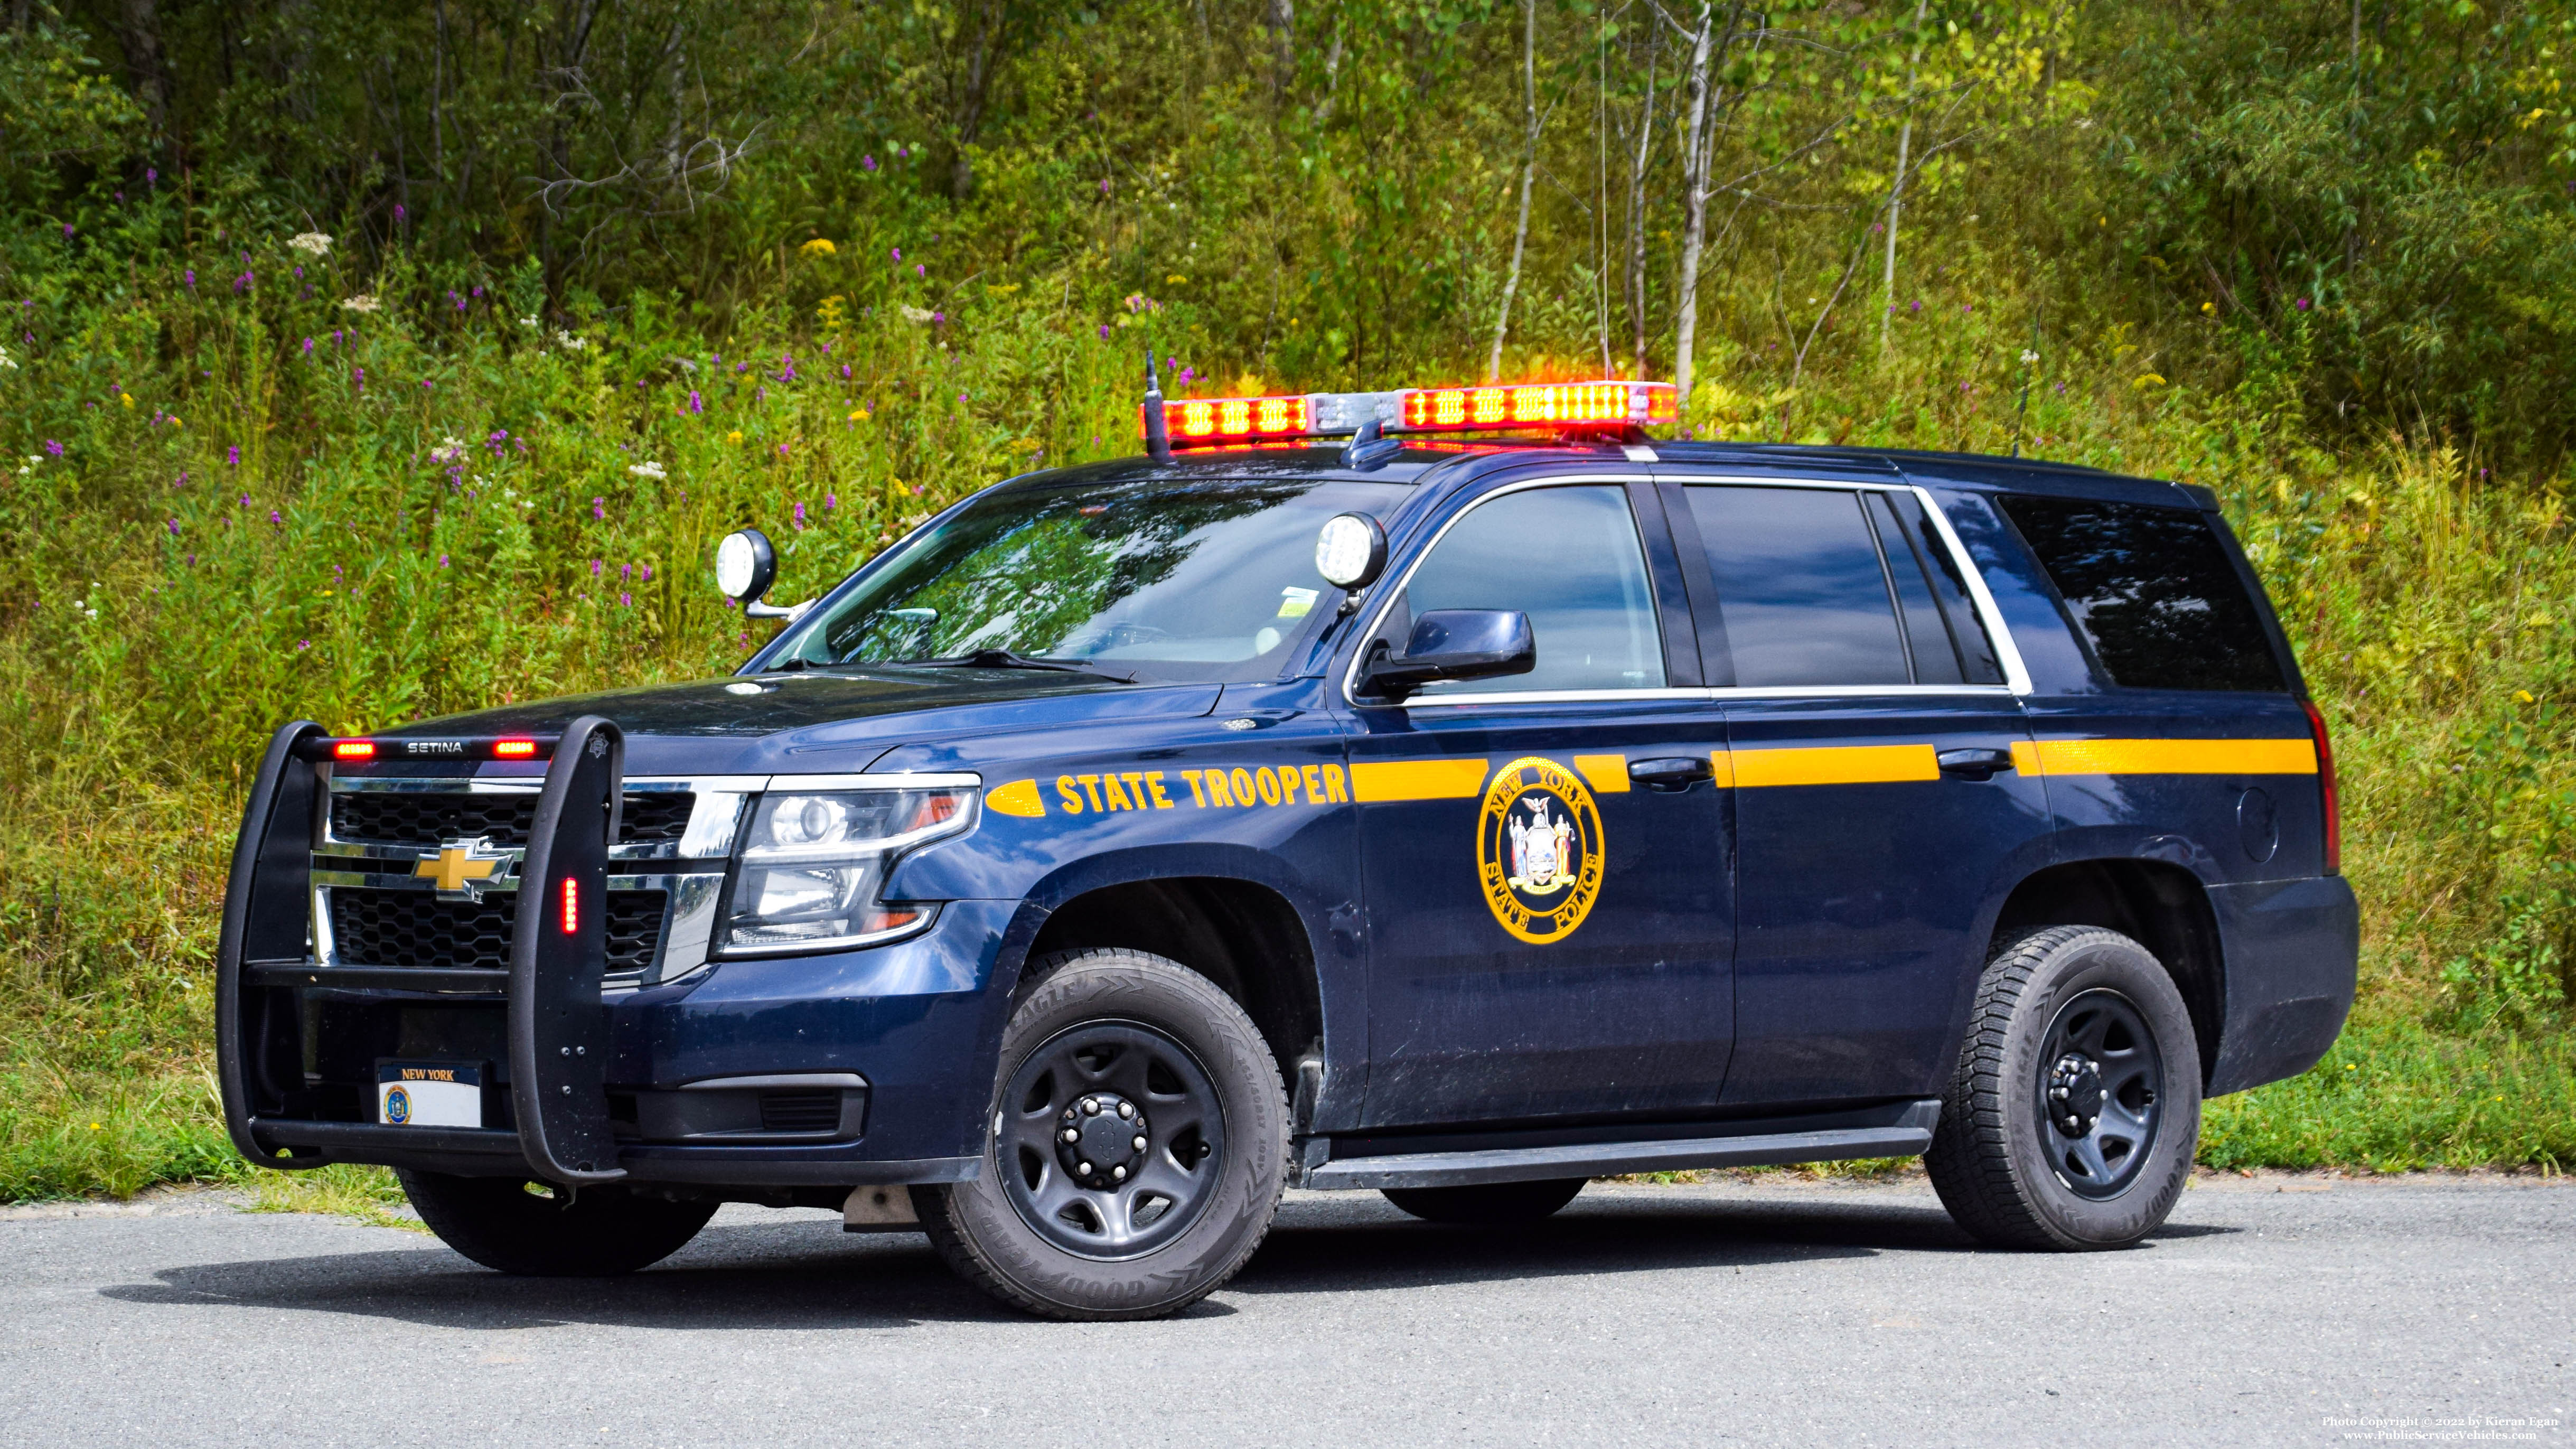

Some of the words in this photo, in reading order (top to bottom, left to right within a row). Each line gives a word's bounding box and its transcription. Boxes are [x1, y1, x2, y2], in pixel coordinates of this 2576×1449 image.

[408, 742, 462, 752] SETINA
[1057, 771, 1174, 814] STATE
[1181, 764, 1348, 807] TROOPER
[1490, 769, 1522, 819] NEW
[1537, 766, 1587, 816] YORK
[1485, 862, 1530, 932] STATE
[1553, 853, 1599, 931] POLICE
[1008, 981, 1075, 1033] EAGLE
[401, 1068, 426, 1080] NEW
[427, 1069, 454, 1081] YORK
[980, 1214, 1145, 1300] GOODYEAR
